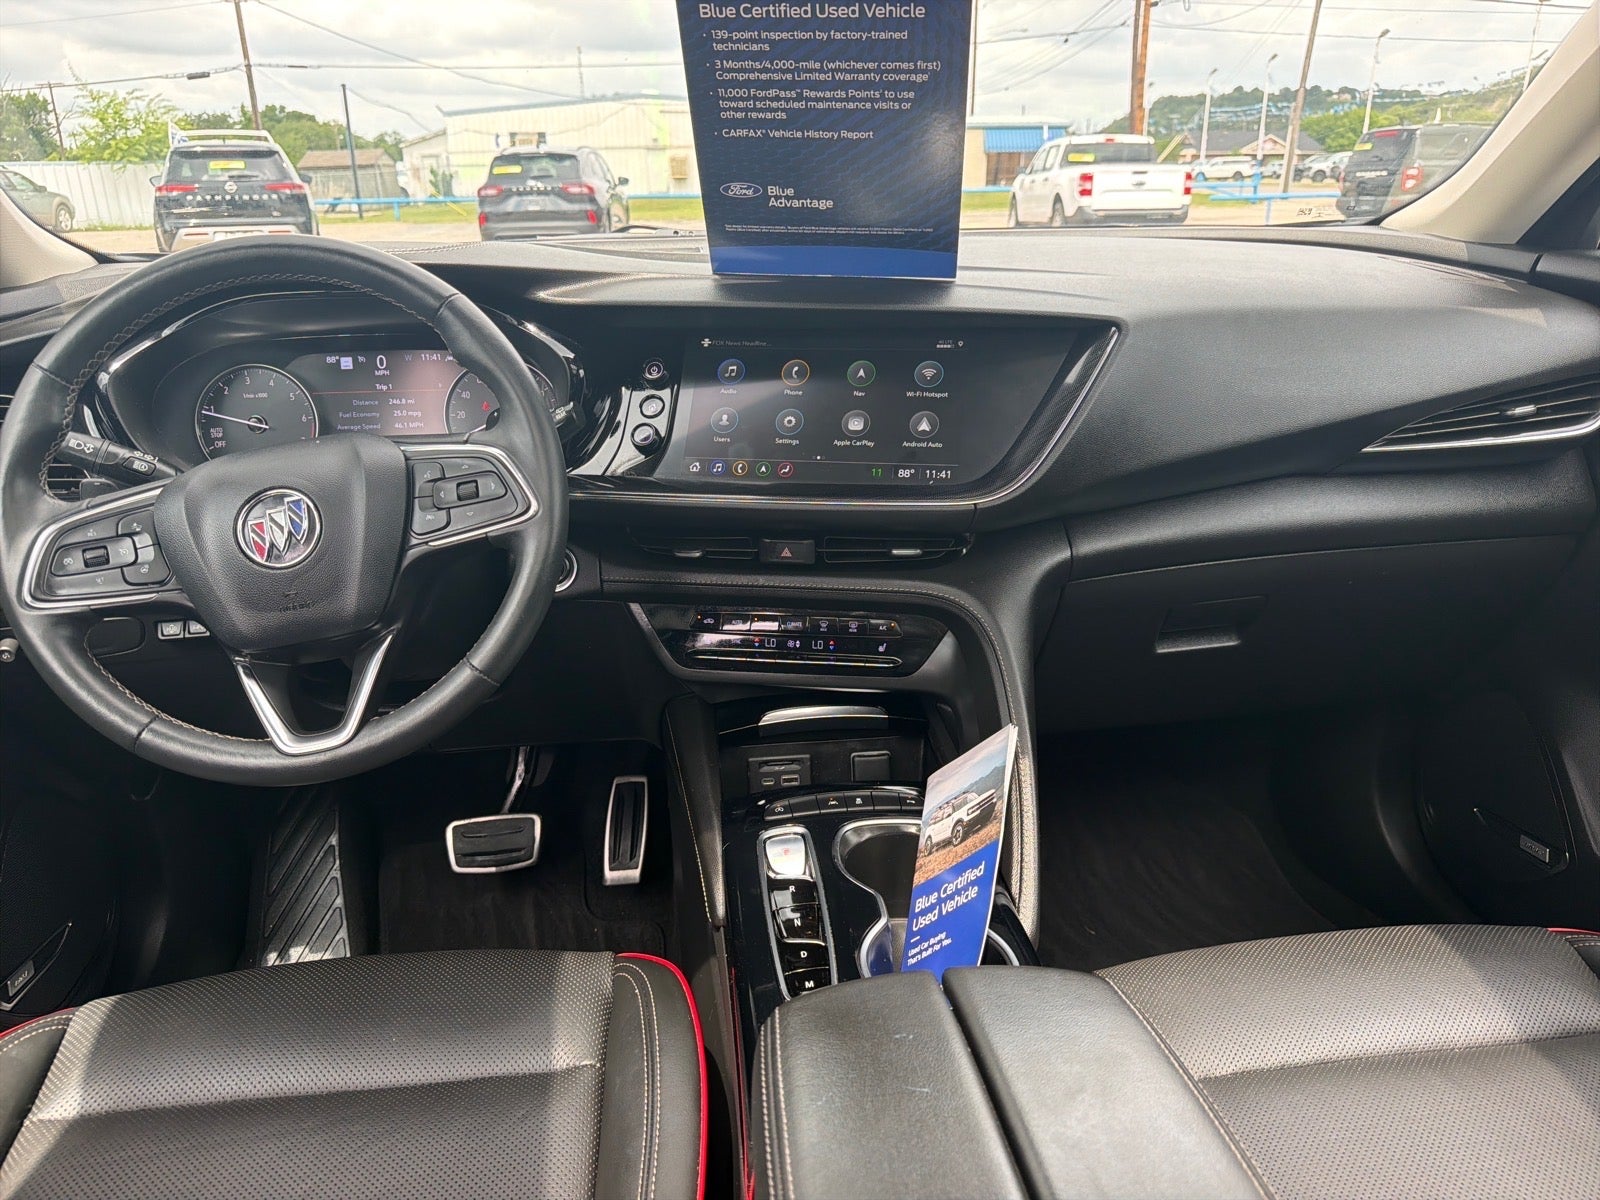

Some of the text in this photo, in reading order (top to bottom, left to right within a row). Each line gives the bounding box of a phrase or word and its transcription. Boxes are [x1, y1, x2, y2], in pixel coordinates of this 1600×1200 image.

[699, 3, 926, 18] Blue Certified Used Vehicle
[711, 30, 908, 41] 139-point inspection by factory-trained
[713, 42, 770, 51] technicians
[715, 60, 941, 71] 3 Months/4,000-mile (whichever comes first)
[716, 71, 793, 81] Comprehensive
[795, 71, 832, 80] Limited
[834, 72, 880, 82] Warranty
[718, 89, 748, 98] 11,000
[803, 89, 846, 98] Rewards
[884, 90, 895, 98] to
[897, 91, 915, 99] use
[719, 100, 754, 109] toward
[756, 100, 805, 109] scheduled
[808, 100, 872, 109] maintenance
[873, 101, 899, 109] visits
[720, 110, 787, 119] other rewards
[768, 130, 802, 138] Vehicle
[804, 130, 838, 139] History
[840, 130, 874, 140] Report
[728, 185, 795, 196] Ford Blue
[768, 197, 834, 209] Advantage
[376, 354, 387, 369] 0
[421, 353, 441, 361] 11:41
[245, 377, 251, 385] 3
[223, 387, 230, 395] 2
[461, 391, 471, 399] 40
[923, 391, 948, 399] Hotspot
[289, 393, 296, 401] 5
[456, 411, 466, 419] 20
[775, 437, 800, 446] Settings
[852, 440, 875, 448] CarPlay
[898, 468, 915, 478] 88°
[926, 470, 951, 479] 11:41
[765, 638, 777, 648] LO
[812, 640, 824, 650] LO
[915, 861, 985, 913] Blue Certified
[912, 886, 978, 932] Used Vehicle
[793, 918, 801, 927] N
[908, 931, 947, 956] Used Car Buying
[805, 980, 815, 988] M
